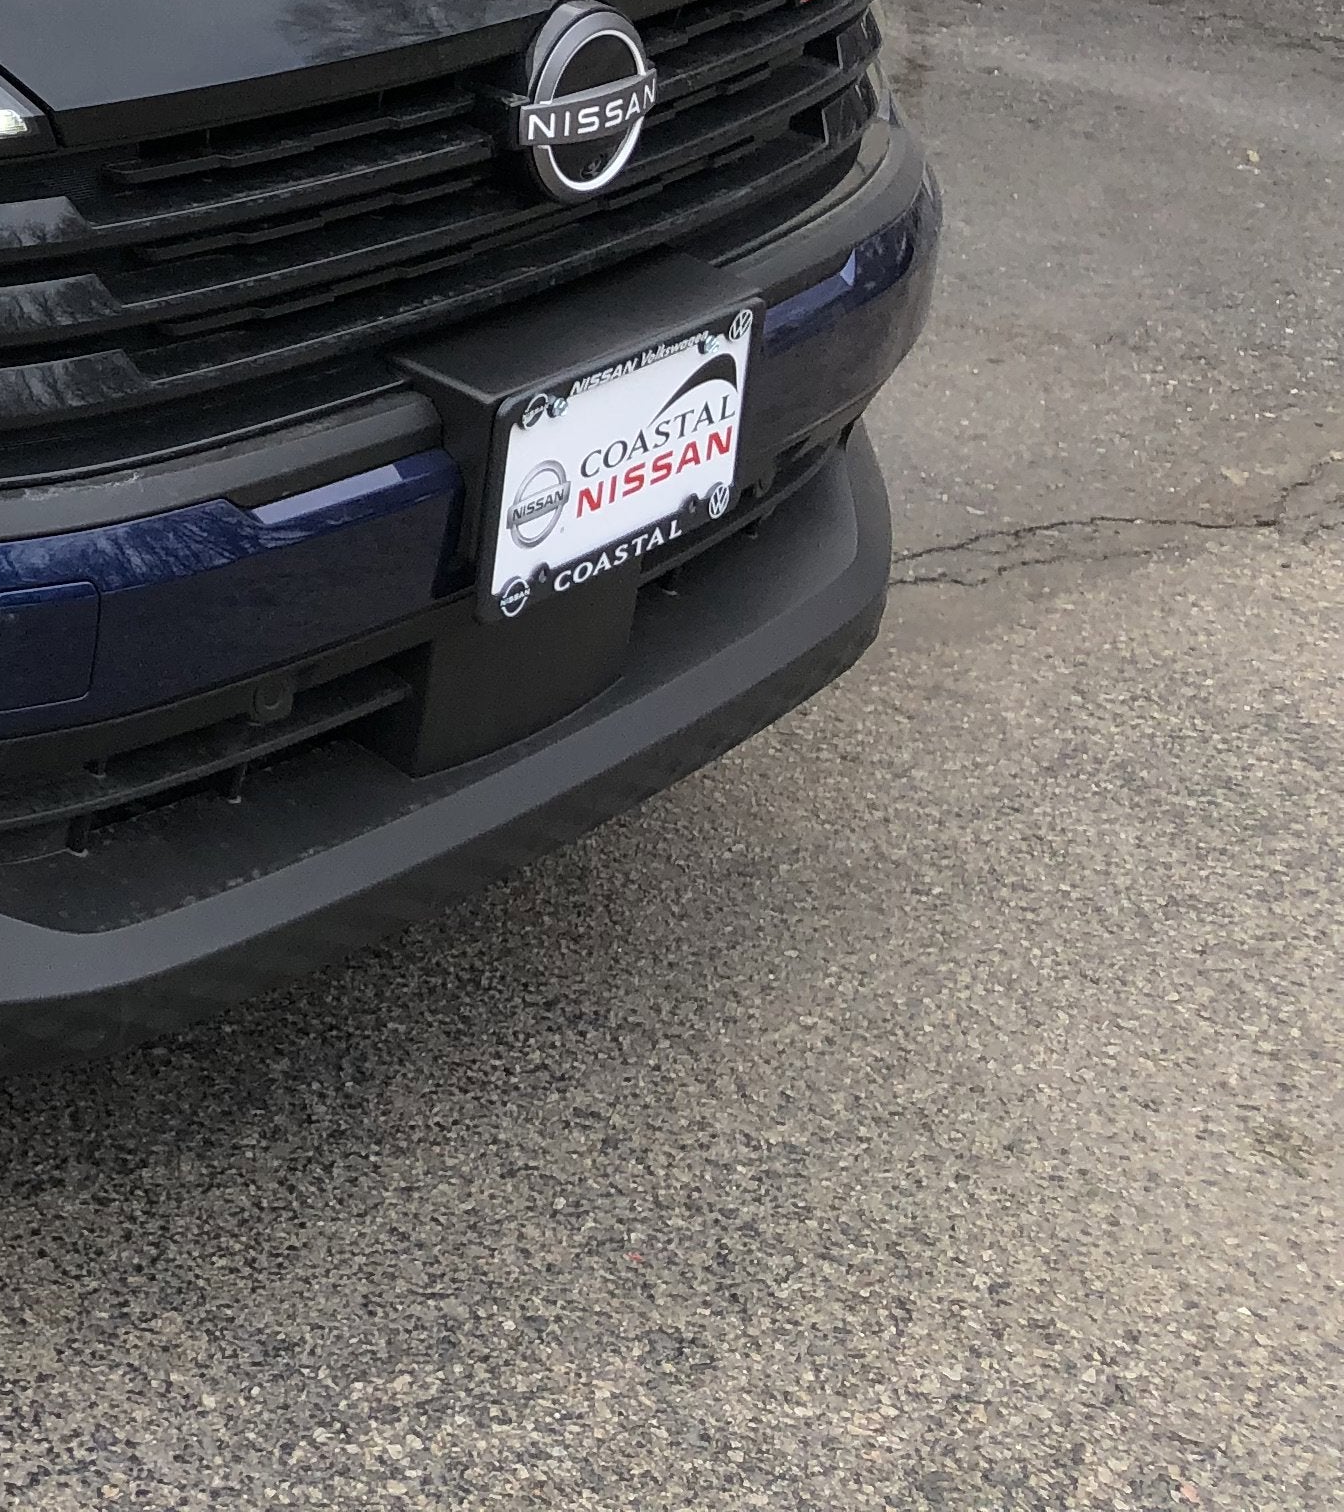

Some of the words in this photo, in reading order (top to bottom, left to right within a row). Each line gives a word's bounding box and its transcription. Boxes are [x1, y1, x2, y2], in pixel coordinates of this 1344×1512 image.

[528, 77, 656, 141] NISSAN
[569, 357, 639, 396] NISSAN
[580, 394, 736, 478] COASTAL
[512, 488, 564, 522] NISSAN
[576, 425, 733, 518] NISSAN
[553, 519, 682, 592] COASTAL
